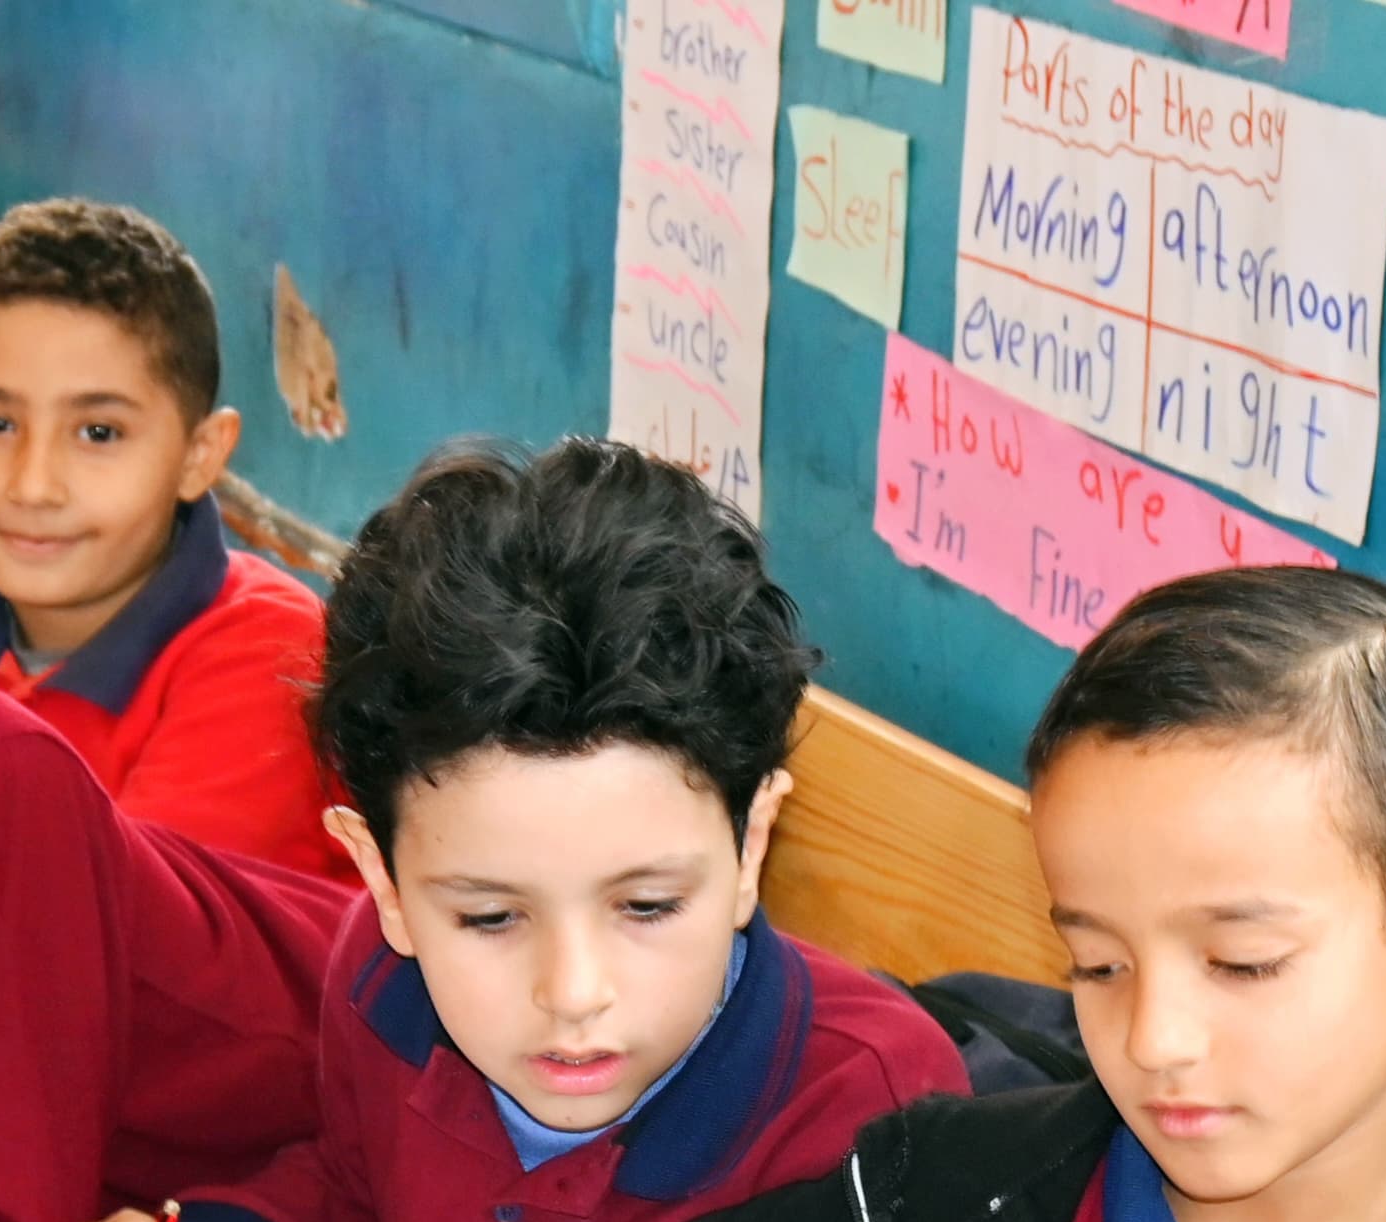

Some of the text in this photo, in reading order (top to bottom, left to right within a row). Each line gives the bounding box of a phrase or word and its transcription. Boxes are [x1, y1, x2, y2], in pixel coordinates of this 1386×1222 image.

[660, 0, 747, 85] brother
[1002, 15, 1090, 127] Parts
[1109, 58, 1147, 142] of
[1163, 70, 1214, 150] the
[1229, 87, 1288, 183] day
[974, 164, 1369, 359] Morning afternoon
[648, 296, 728, 384] uncle
[960, 295, 1331, 498] evening night
[1078, 460, 1167, 547] are
